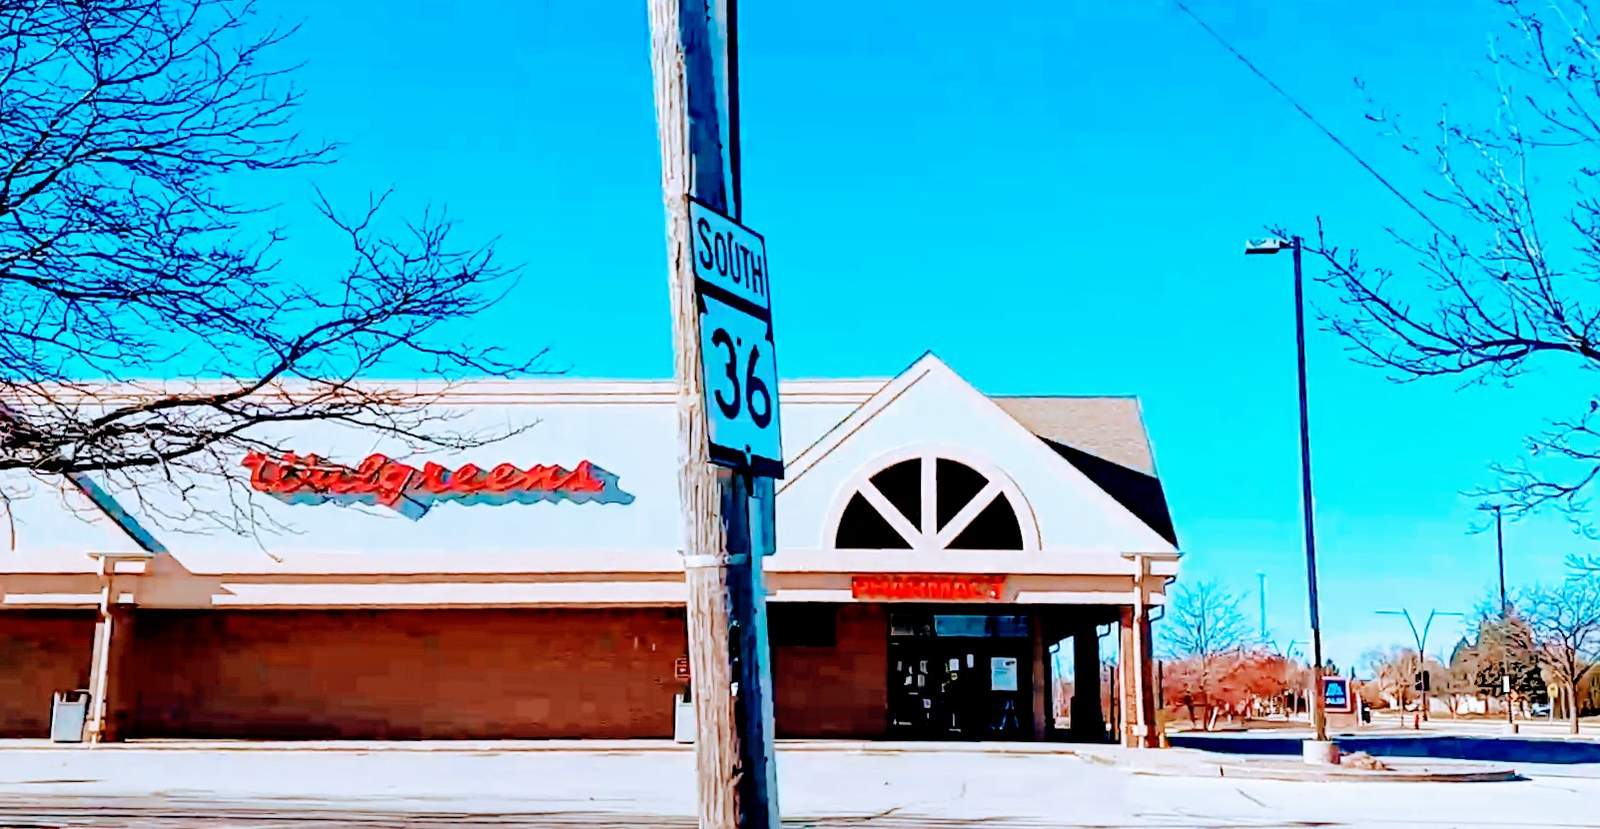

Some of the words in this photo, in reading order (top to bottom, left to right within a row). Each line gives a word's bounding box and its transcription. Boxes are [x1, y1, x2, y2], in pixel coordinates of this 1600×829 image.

[696, 217, 765, 297] SOUTH
[711, 327, 772, 430] 36
[241, 451, 605, 507] Walgreens
